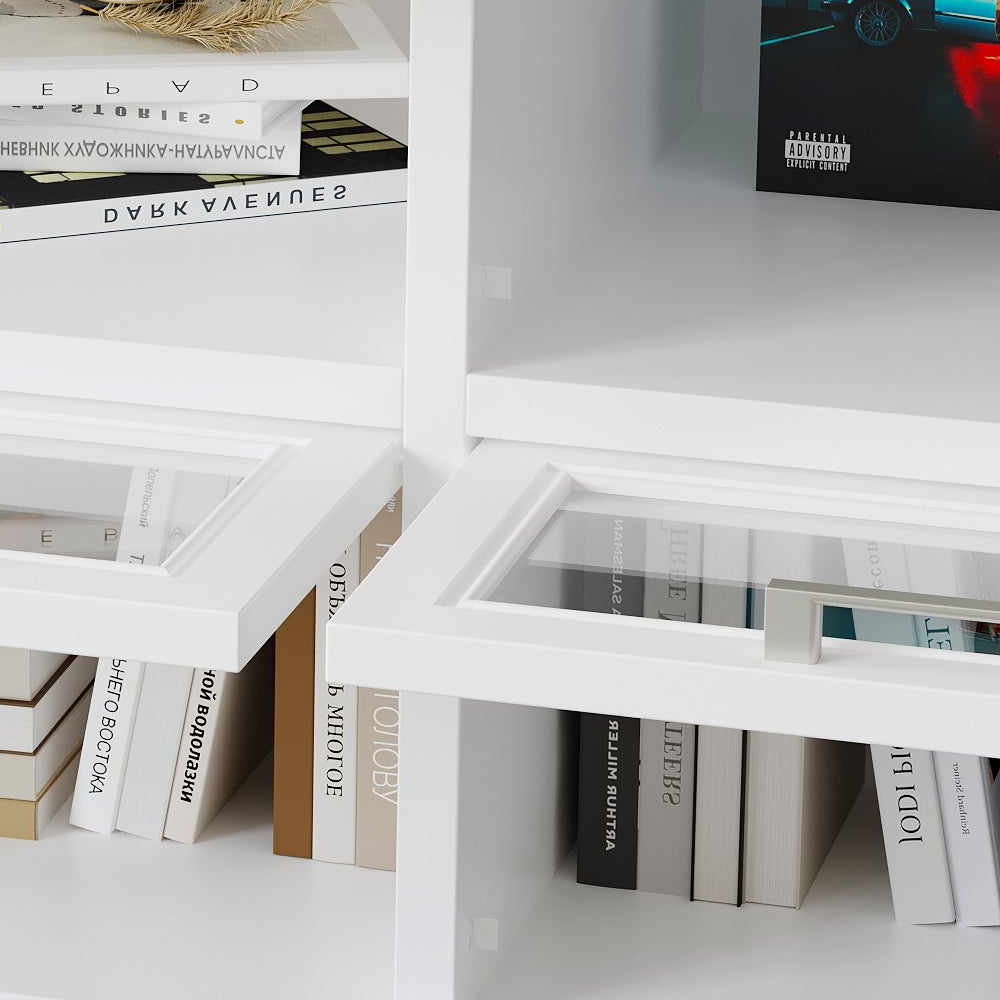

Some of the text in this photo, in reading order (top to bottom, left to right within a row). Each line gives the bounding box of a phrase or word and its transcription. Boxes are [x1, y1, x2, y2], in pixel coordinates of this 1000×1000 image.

[789, 131, 847, 143] PARENTAL
[789, 143, 847, 160] ADVISORY
[786, 159, 848, 171] EXPLICIT CONTENT
[88, 716, 116, 794] ВОСТОКА
[325, 704, 345, 798] МНОГОЕ
